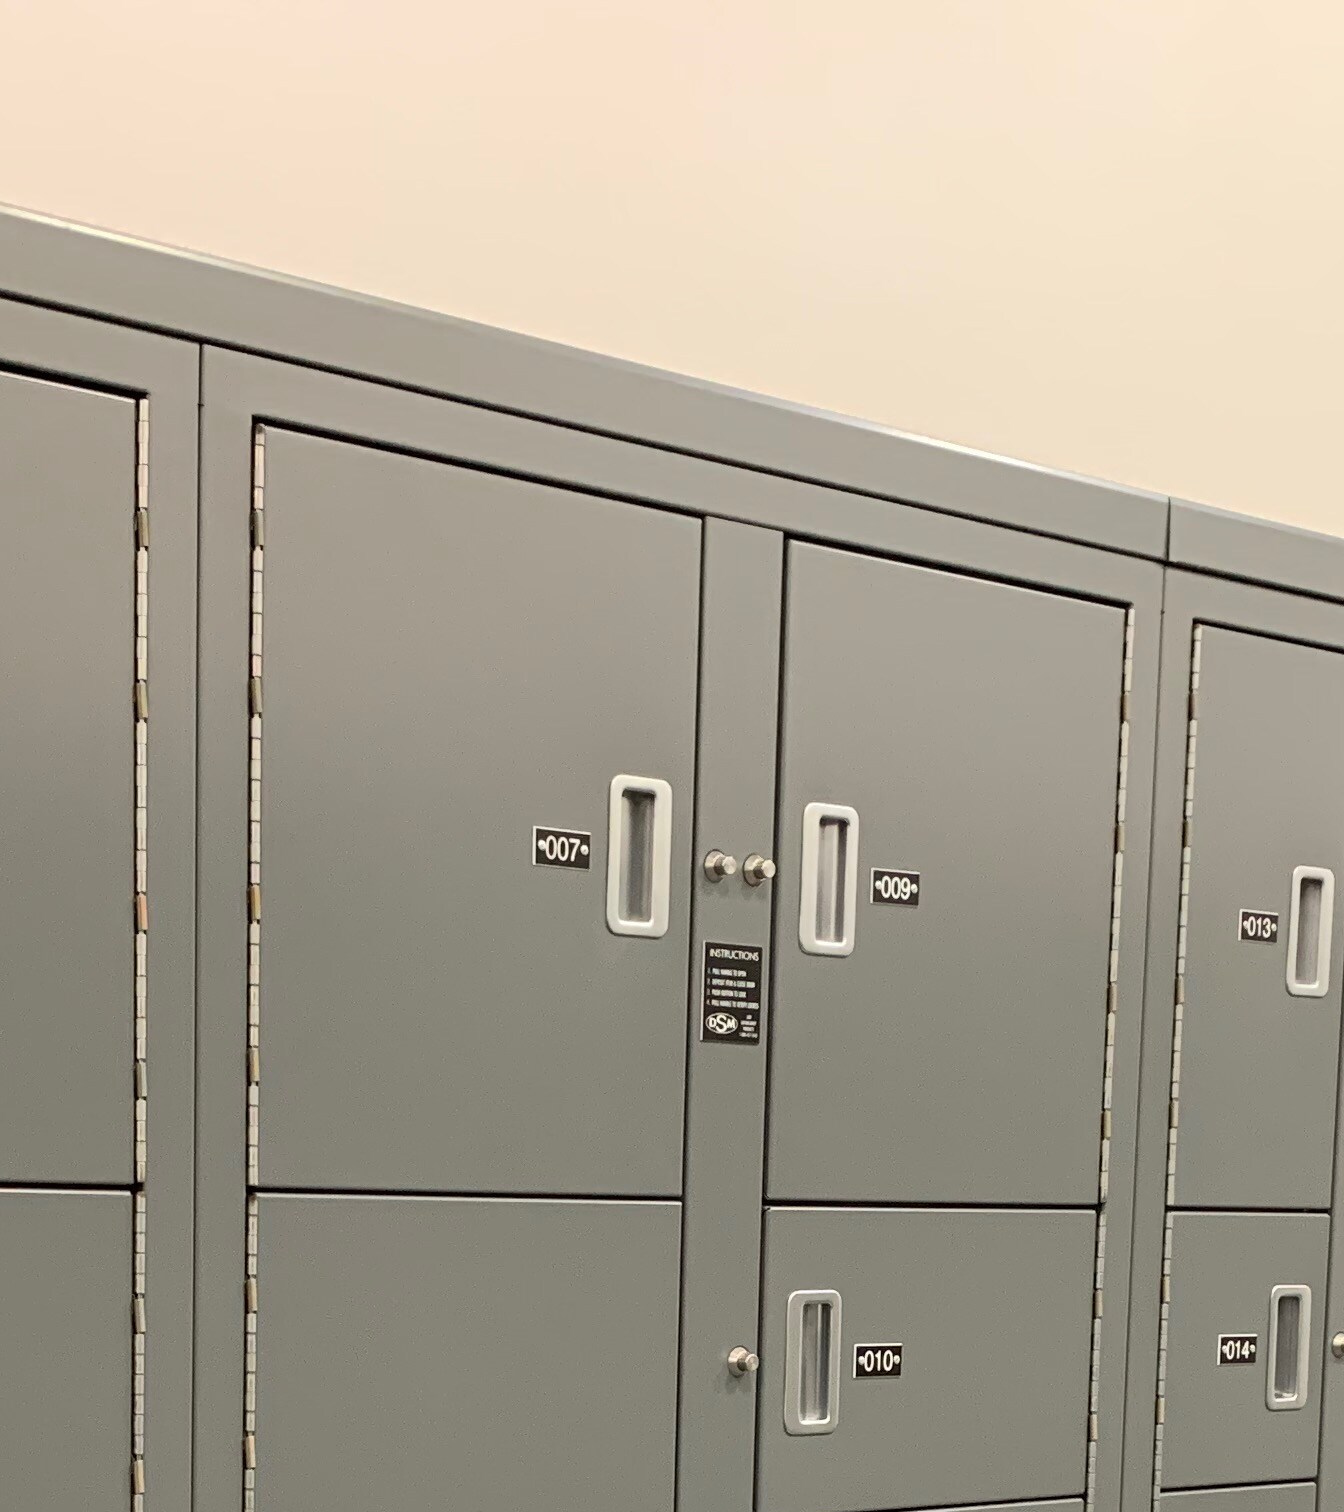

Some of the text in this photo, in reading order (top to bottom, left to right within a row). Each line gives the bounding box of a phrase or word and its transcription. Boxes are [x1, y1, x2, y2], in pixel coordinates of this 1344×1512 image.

[545, 836, 580, 861] 007
[881, 877, 910, 899] 009
[1247, 915, 1271, 938] 013
[709, 948, 760, 962] INSTRUCTIONS
[709, 1014, 736, 1033] DSM
[1226, 1340, 1249, 1359] 014
[864, 1350, 893, 1371] 010
